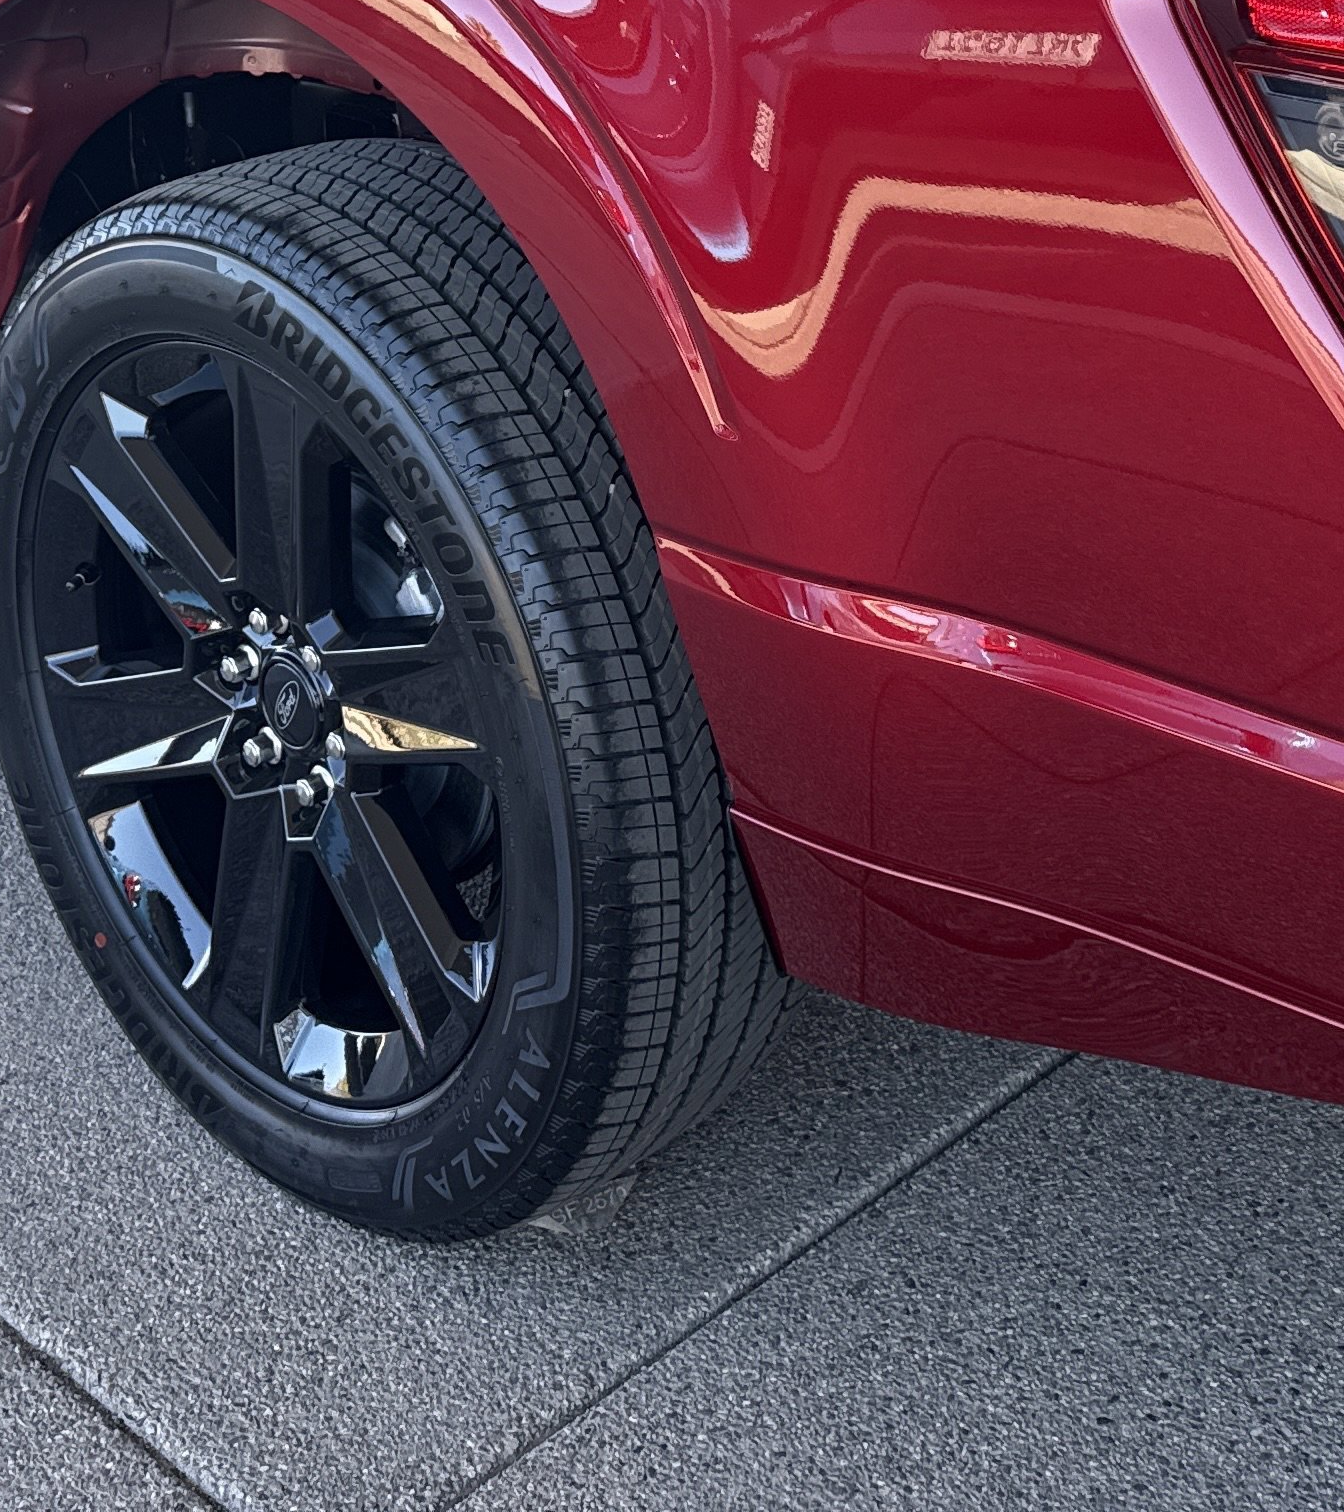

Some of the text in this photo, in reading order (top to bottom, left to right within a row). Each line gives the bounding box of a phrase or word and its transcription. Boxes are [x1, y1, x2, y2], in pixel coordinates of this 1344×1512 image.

[231, 278, 517, 669] BRIDGESTONE
[423, 1028, 552, 1202] ALENZA
[550, 1202, 579, 1226] SF
